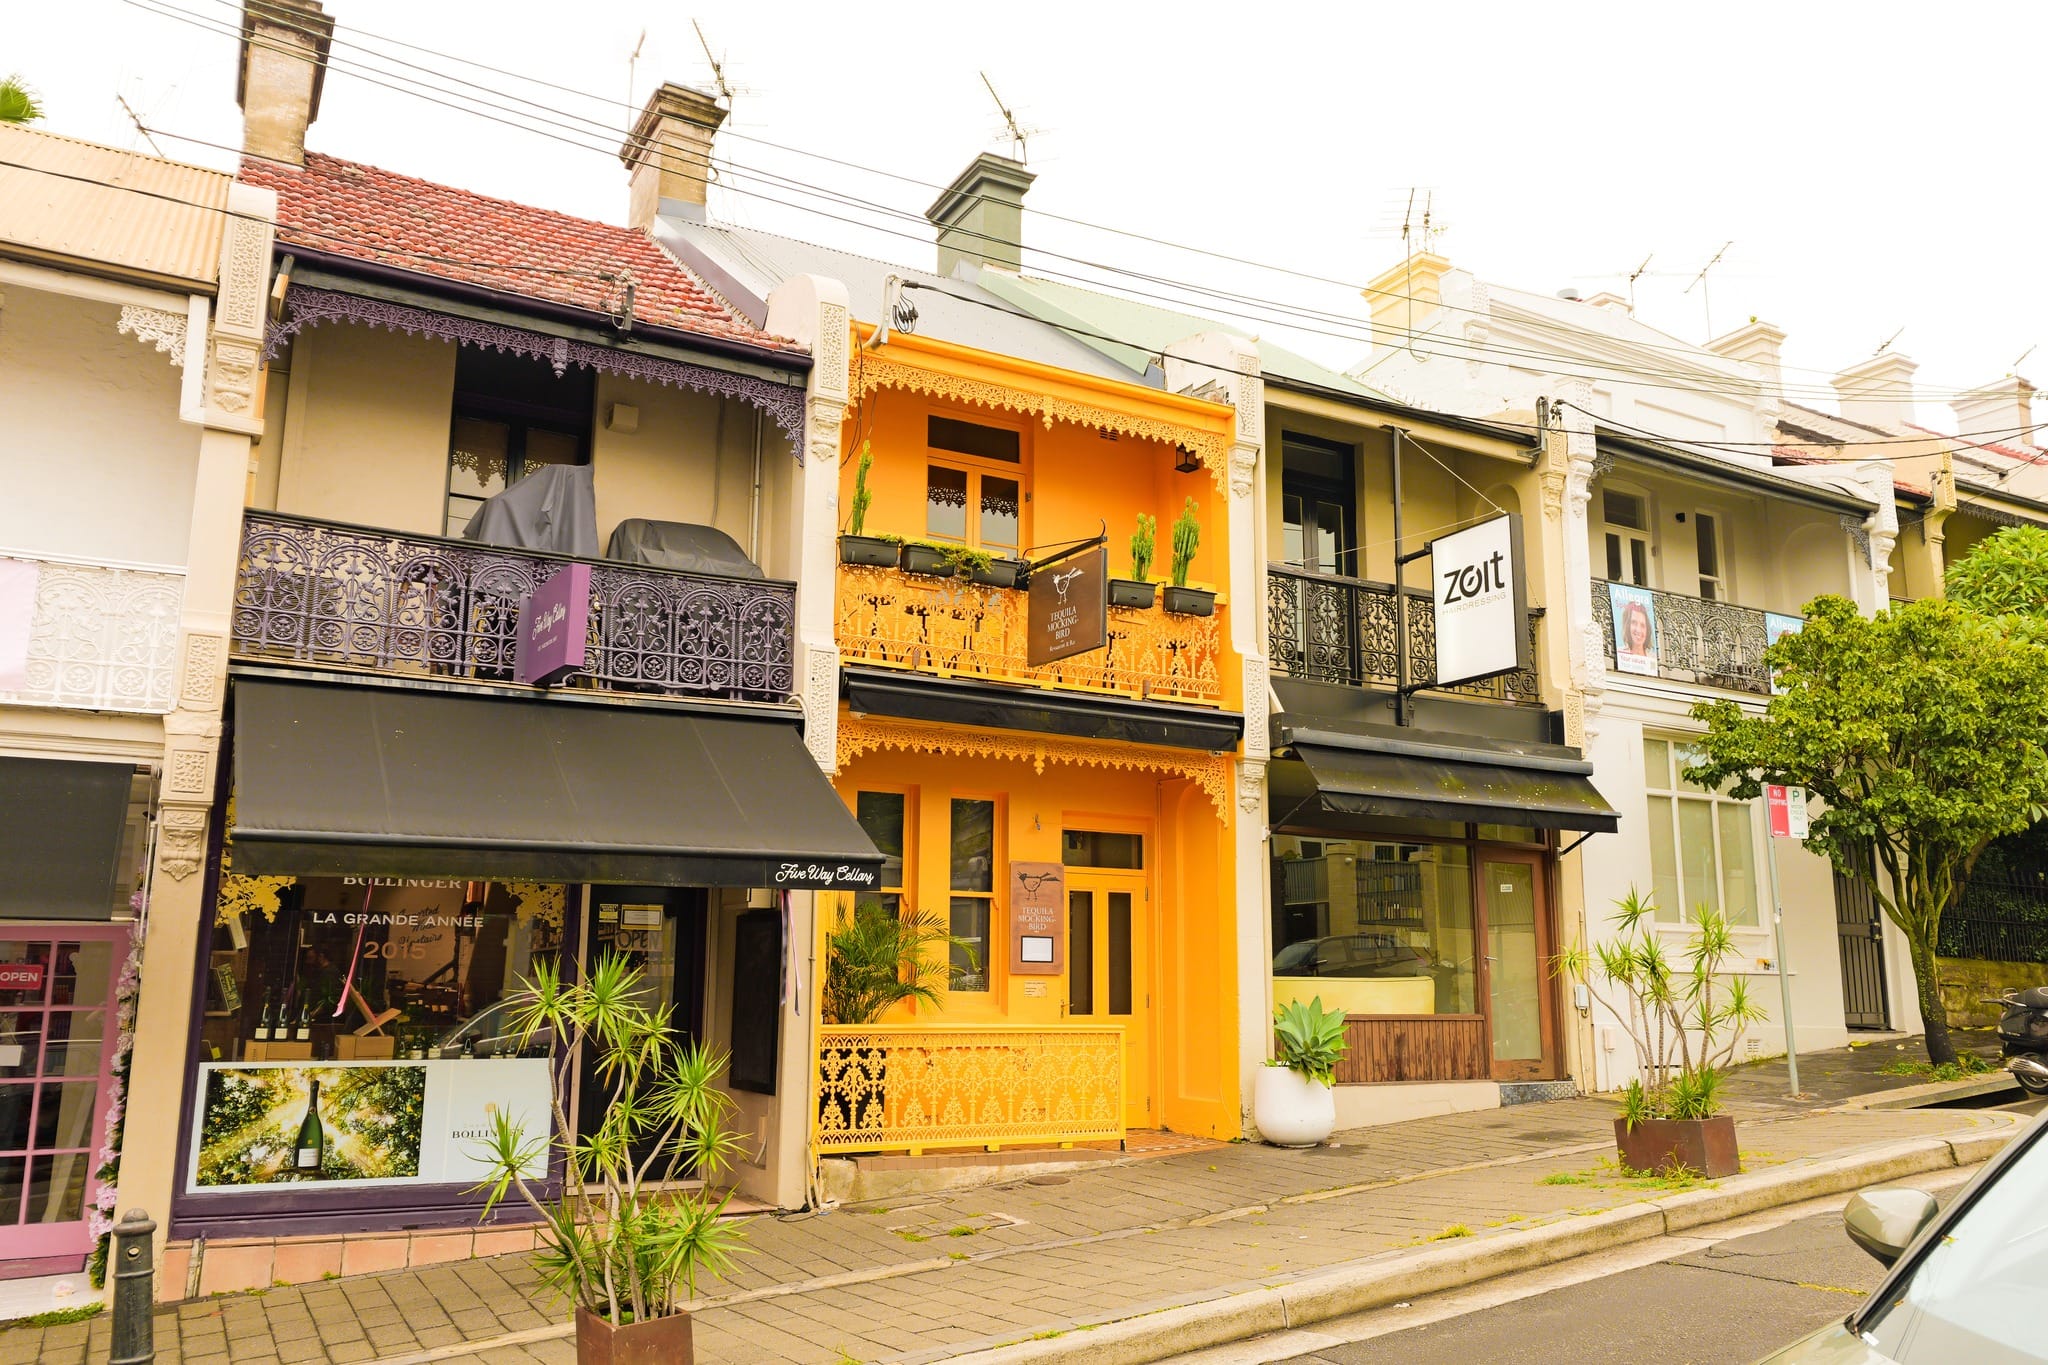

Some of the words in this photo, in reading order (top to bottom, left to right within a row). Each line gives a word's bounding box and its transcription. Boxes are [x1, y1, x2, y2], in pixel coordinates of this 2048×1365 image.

[1442, 591, 1506, 616] HAIRDRESSING
[1614, 587, 1651, 606] Allegra
[1050, 605, 1077, 622] TEQUILA
[1055, 627, 1071, 640] BIRD
[1773, 789, 1782, 798] NO
[1792, 790, 1800, 802] P
[775, 863, 806, 882] Five
[807, 864, 834, 886] Way
[836, 865, 874, 885] Cellars
[1022, 906, 1054, 915] TEQUILA
[313, 912, 337, 924] LA
[343, 913, 419, 926] GRANDE
[424, 914, 484, 928] ANNÉE
[1028, 922, 1047, 931] BIRD
[363, 941, 426, 960] 2015
[0, 971, 38, 982] OPEN
